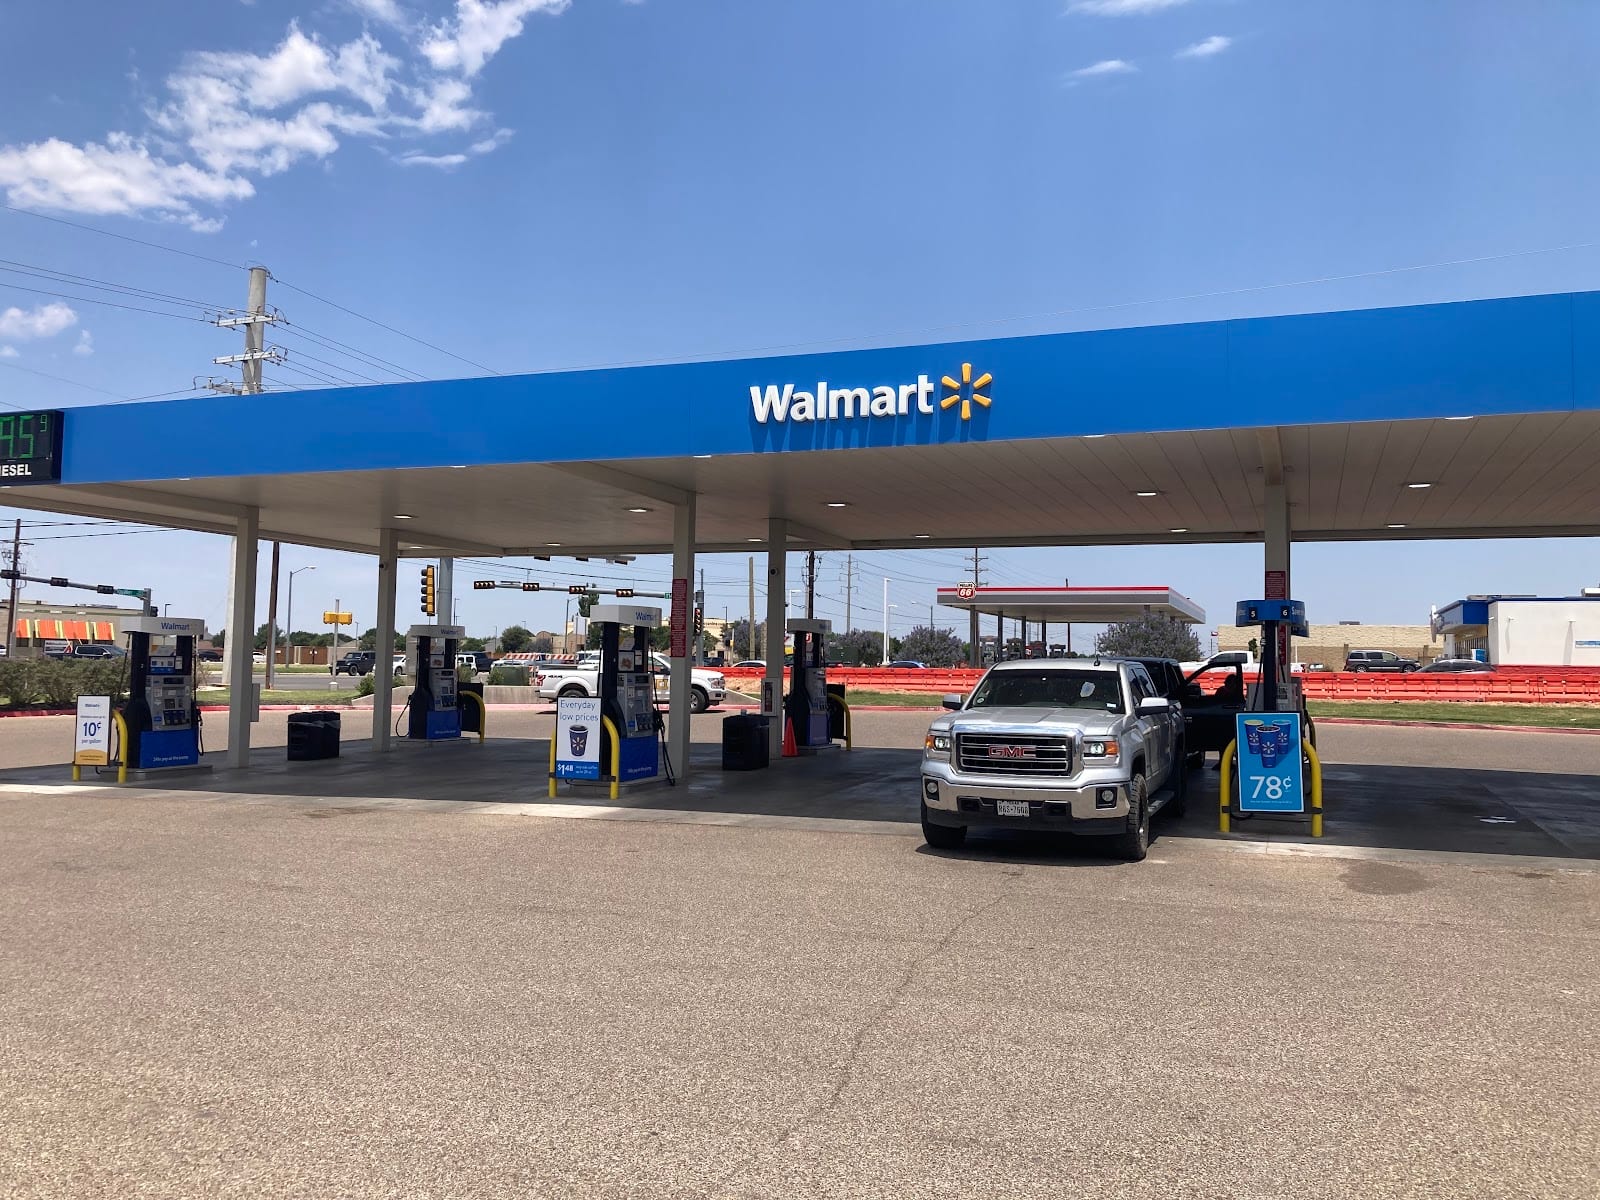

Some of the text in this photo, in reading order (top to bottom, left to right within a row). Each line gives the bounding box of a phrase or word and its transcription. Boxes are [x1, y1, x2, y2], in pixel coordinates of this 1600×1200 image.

[750, 375, 934, 424] Walmart
[959, 588, 972, 596] 66
[1250, 610, 1256, 618] 5
[161, 622, 190, 631] Walmart
[560, 700, 596, 711] Everyday
[560, 713, 599, 722] low prices
[988, 745, 1037, 759] GMC
